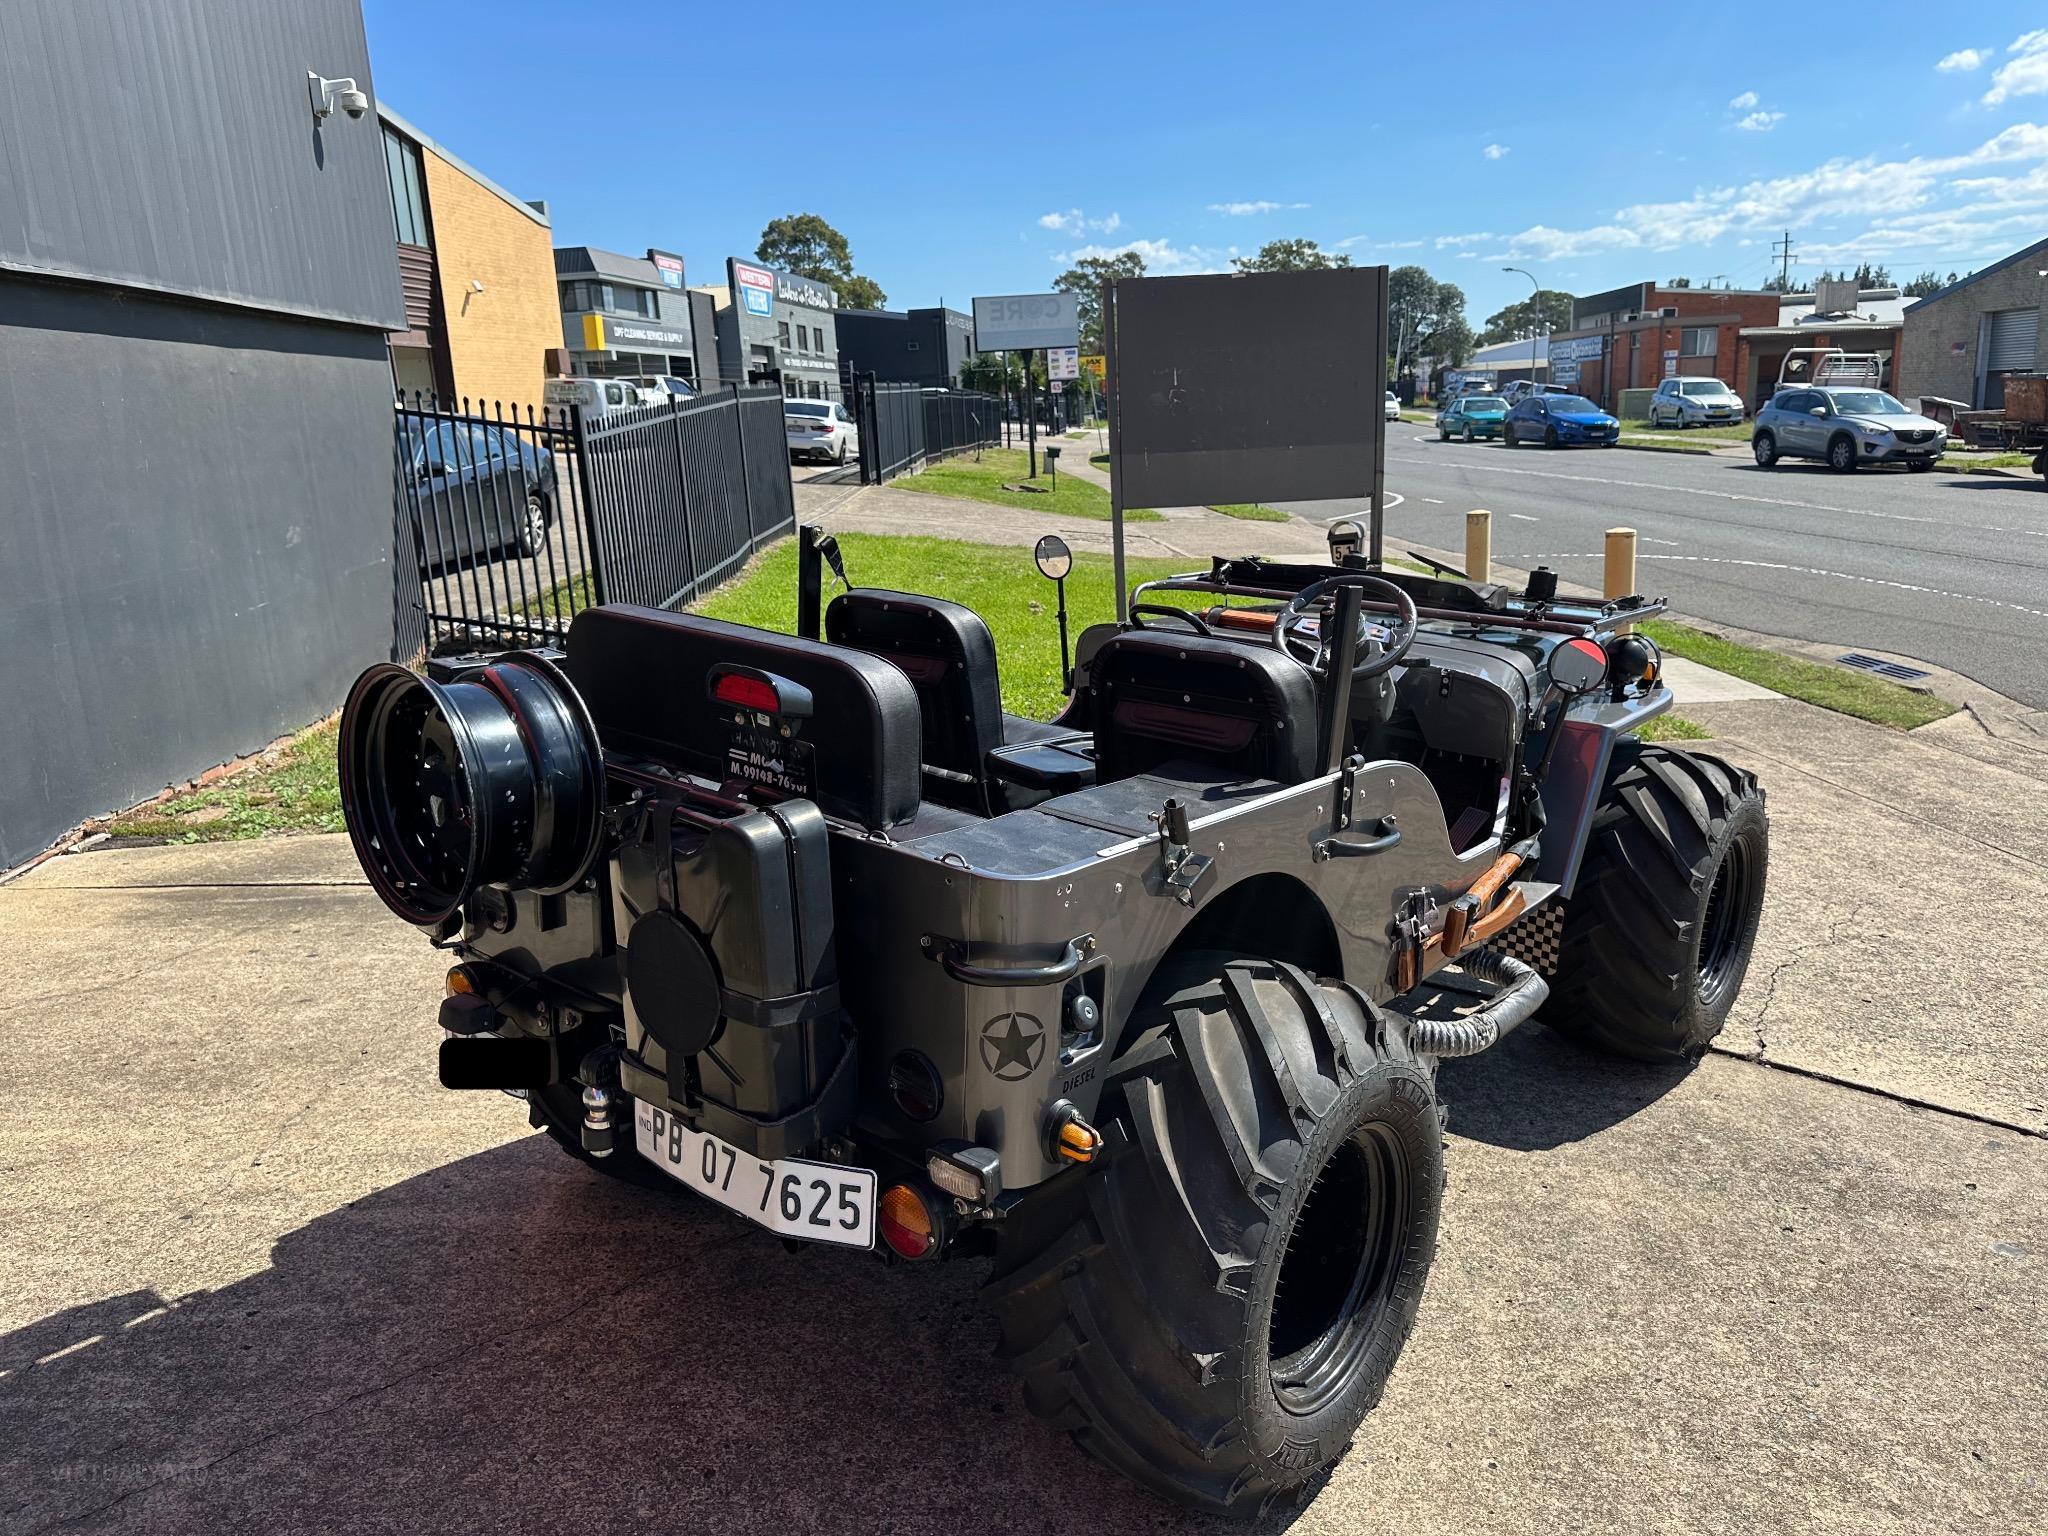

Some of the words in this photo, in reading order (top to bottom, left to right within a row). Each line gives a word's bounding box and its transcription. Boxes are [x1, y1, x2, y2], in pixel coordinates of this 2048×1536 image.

[1062, 1066, 1096, 1094] DIESEL
[652, 1108, 683, 1165] PB
[701, 1138, 737, 1192] 07
[759, 1164, 862, 1231] 7625
